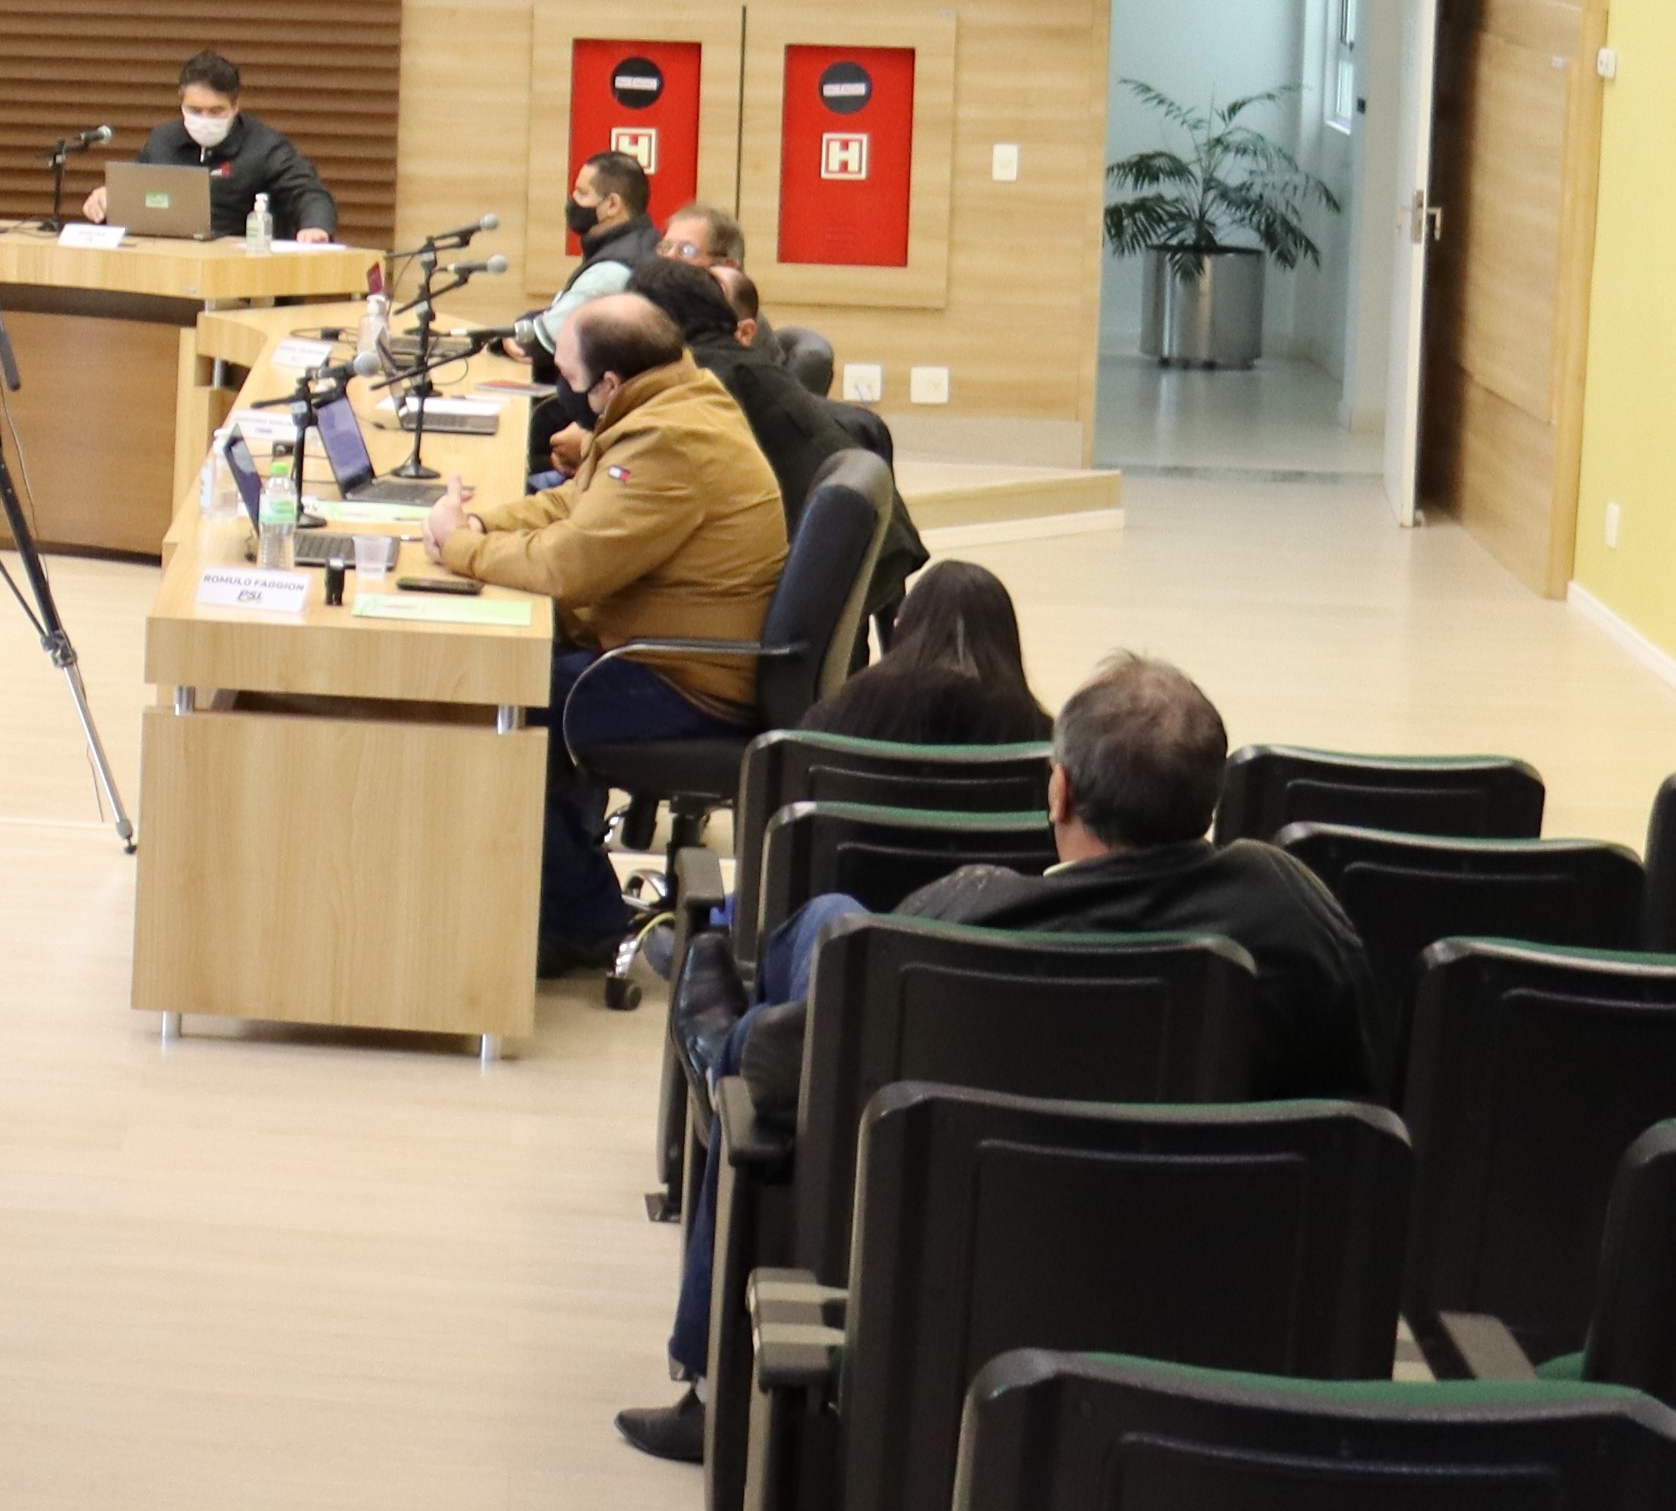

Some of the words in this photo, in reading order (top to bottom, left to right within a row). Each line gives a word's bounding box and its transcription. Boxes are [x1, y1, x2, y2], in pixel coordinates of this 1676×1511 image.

[828, 141, 861, 172] H
[204, 575, 251, 585] ROMULO
[254, 580, 304, 590] FAGGION
